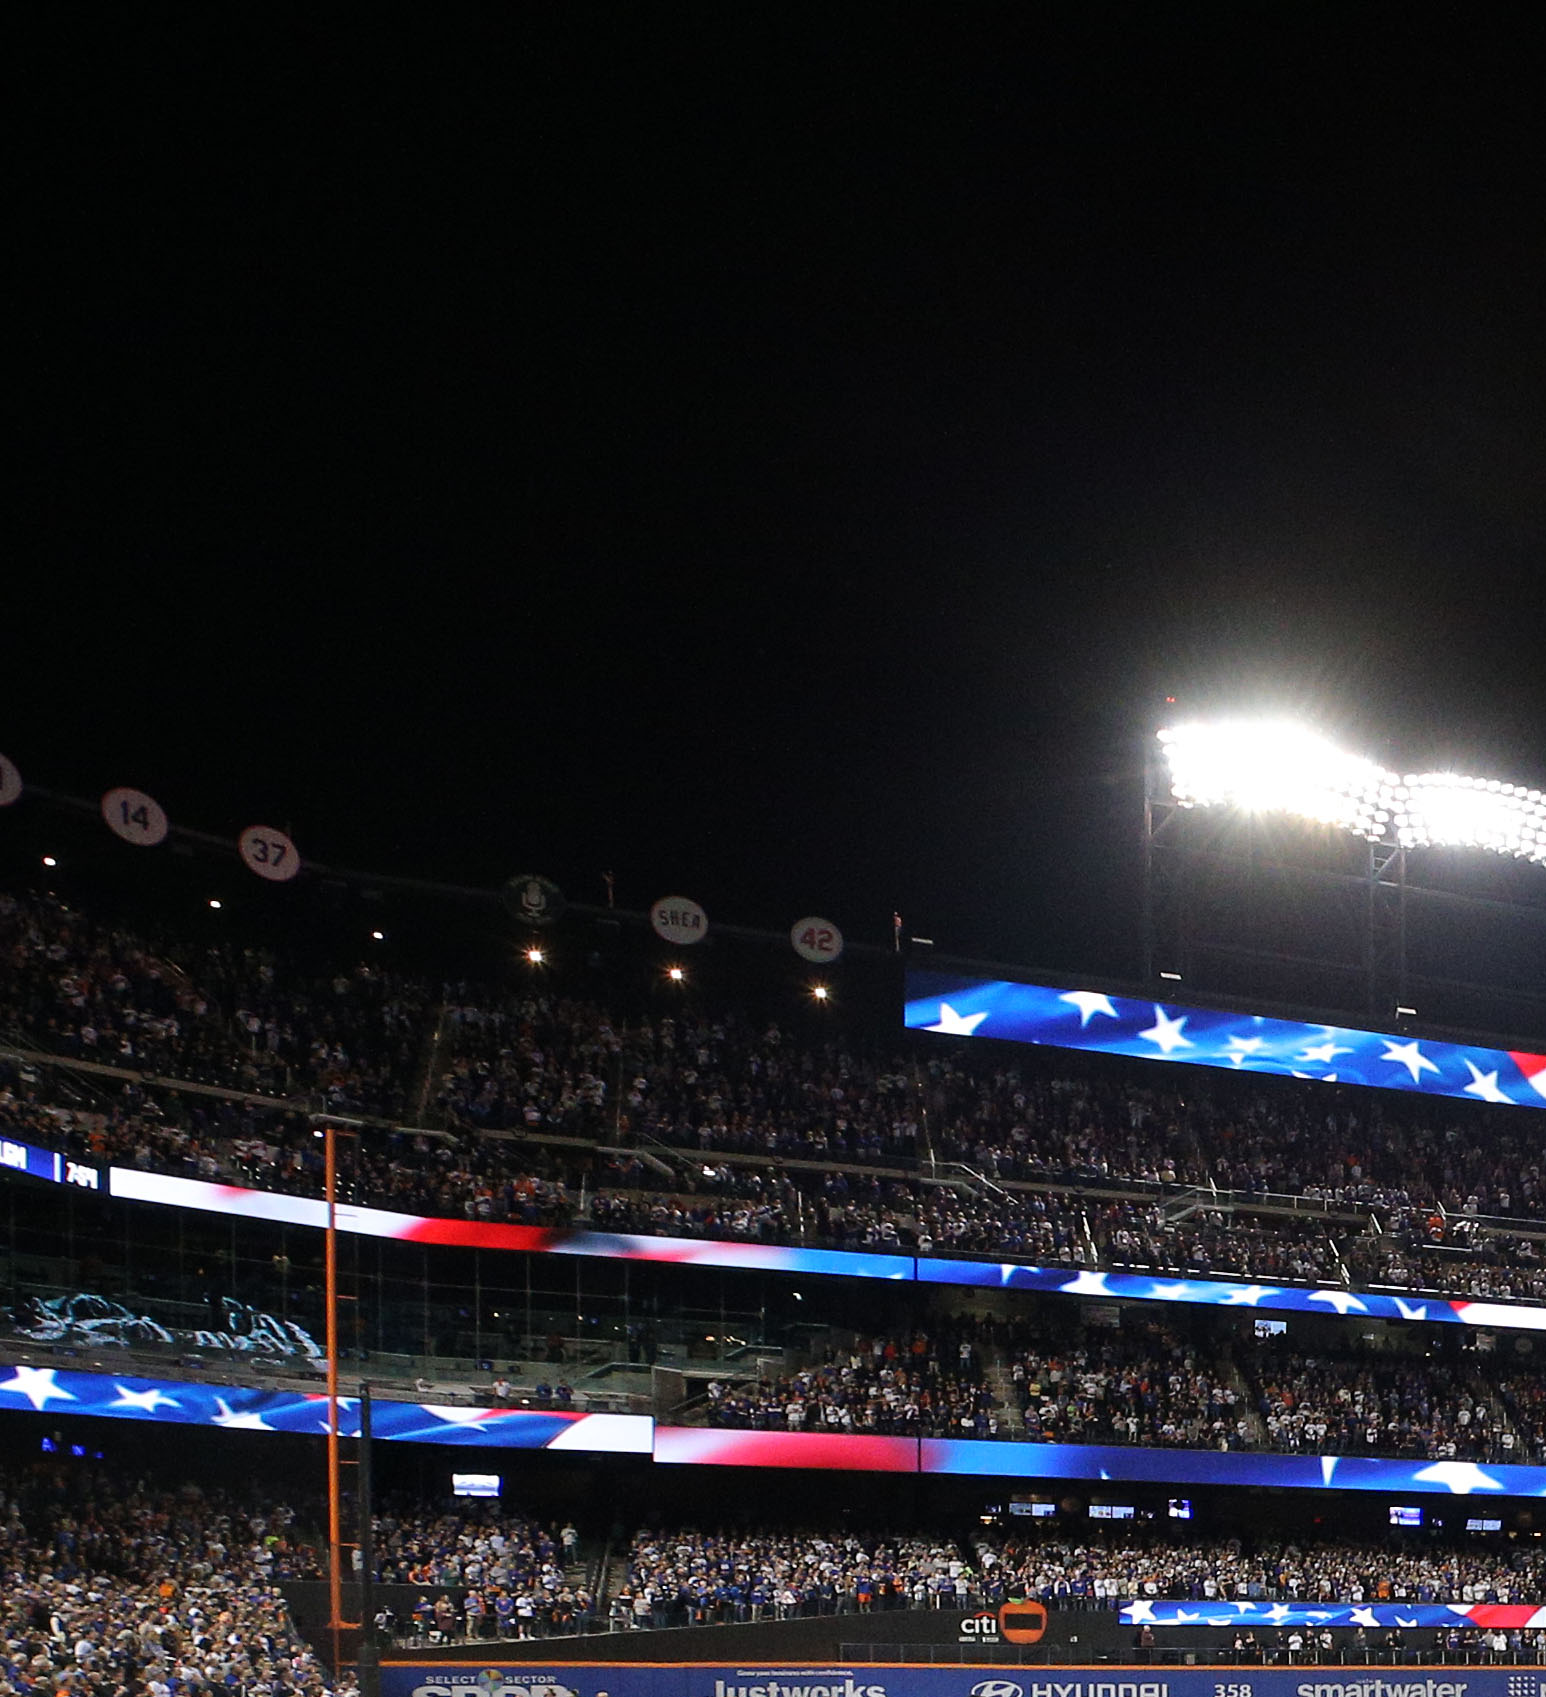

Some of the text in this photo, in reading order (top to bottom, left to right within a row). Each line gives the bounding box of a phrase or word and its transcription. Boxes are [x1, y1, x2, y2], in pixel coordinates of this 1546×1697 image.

[120, 800, 150, 831] 14
[252, 837, 288, 868] 37
[658, 908, 702, 930] SHEA
[800, 926, 834, 952] 42
[960, 1613, 997, 1635] citi
[425, 1675, 556, 1685] SELECT SECTOR
